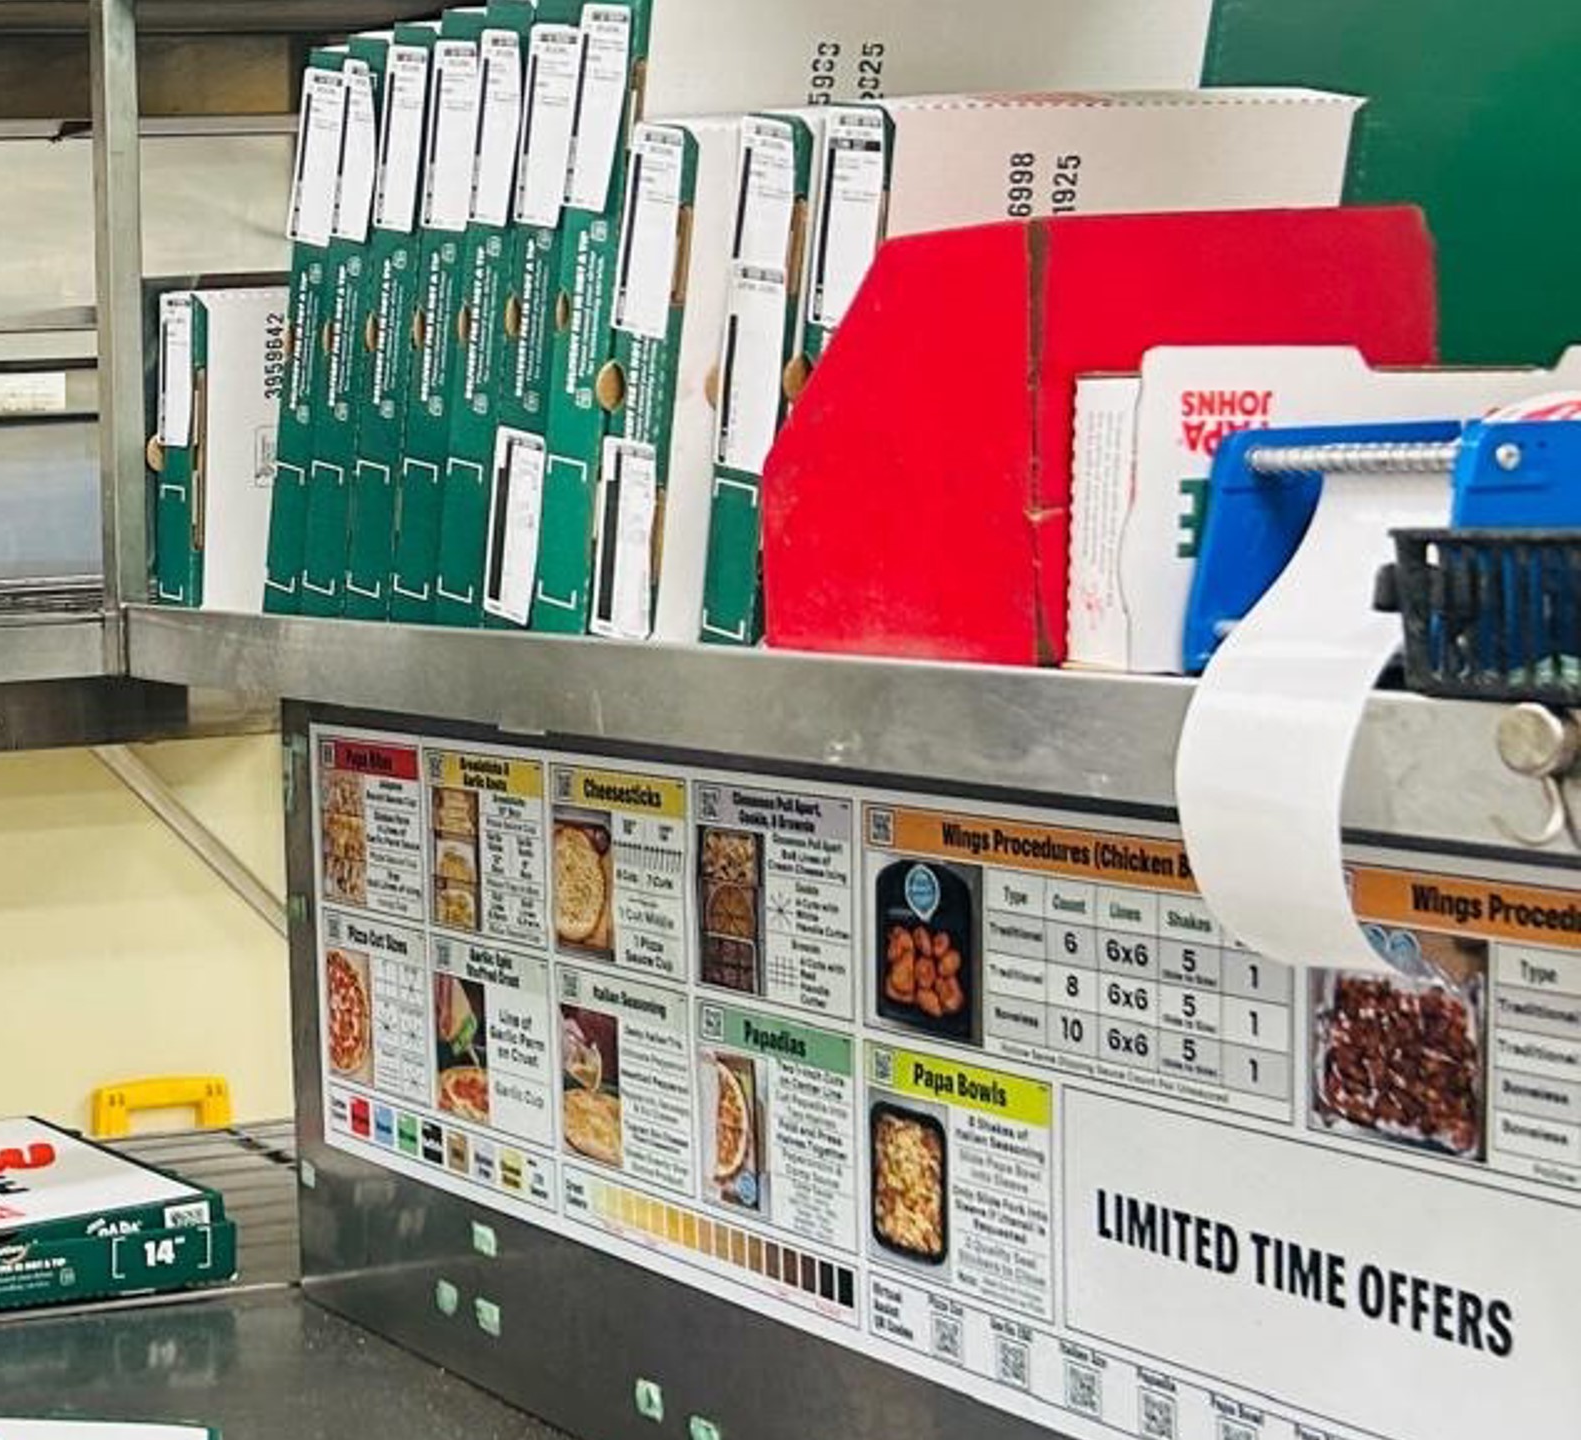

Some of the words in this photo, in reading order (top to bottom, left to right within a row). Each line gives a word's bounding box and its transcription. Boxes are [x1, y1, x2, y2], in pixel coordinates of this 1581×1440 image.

[1008, 153, 1034, 217] 6998
[1052, 155, 1081, 214] 1925
[1182, 390, 1272, 416] JOHNS
[583, 778, 662, 808] Cheesesticks
[777, 796, 793, 812] Pull
[779, 814, 815, 834] Brownie
[942, 822, 989, 855] Wings
[993, 828, 1091, 866] Procedures
[1094, 841, 1174, 878] (Chicken
[1004, 886, 1028, 906] Type
[1052, 894, 1086, 914] Count
[1109, 904, 1141, 922] Lines
[1167, 911, 1213, 933] Shakes
[1411, 884, 1483, 923] Wings
[347, 925, 368, 945] Pizza
[368, 932, 384, 949] Cut
[386, 935, 408, 955] Sizes
[1064, 932, 1078, 954] 6
[1107, 938, 1149, 967] 6x6
[1182, 949, 1196, 973] 5
[1249, 964, 1259, 990] 1
[1520, 959, 1559, 985] Type
[592, 985, 620, 1006] Italian
[1066, 975, 1079, 997] 8
[1107, 983, 1149, 1011] 6x6
[1182, 994, 1196, 1018] 5
[1249, 1010, 1259, 1037] 1
[1498, 997, 1579, 1024] Traditional
[499, 1009, 520, 1027] Line
[522, 1014, 533, 1029] of
[490, 1025, 518, 1047] Garlic
[520, 1034, 545, 1052] Parm
[743, 1020, 806, 1058] Papadias
[1061, 1016, 1083, 1043] 10
[1107, 1028, 1149, 1057] 6x6
[1182, 1039, 1196, 1062] 5
[1249, 1058, 1259, 1083] 1
[913, 1063, 955, 1096] Papa
[957, 1074, 1008, 1107] Bowls
[986, 1155, 1013, 1175] Papa
[989, 1136, 1046, 1165] Seasoning
[1096, 1187, 1239, 1275] LIMITED
[1249, 1231, 1346, 1309] TIME
[1357, 1264, 1514, 1358] OFFERS
